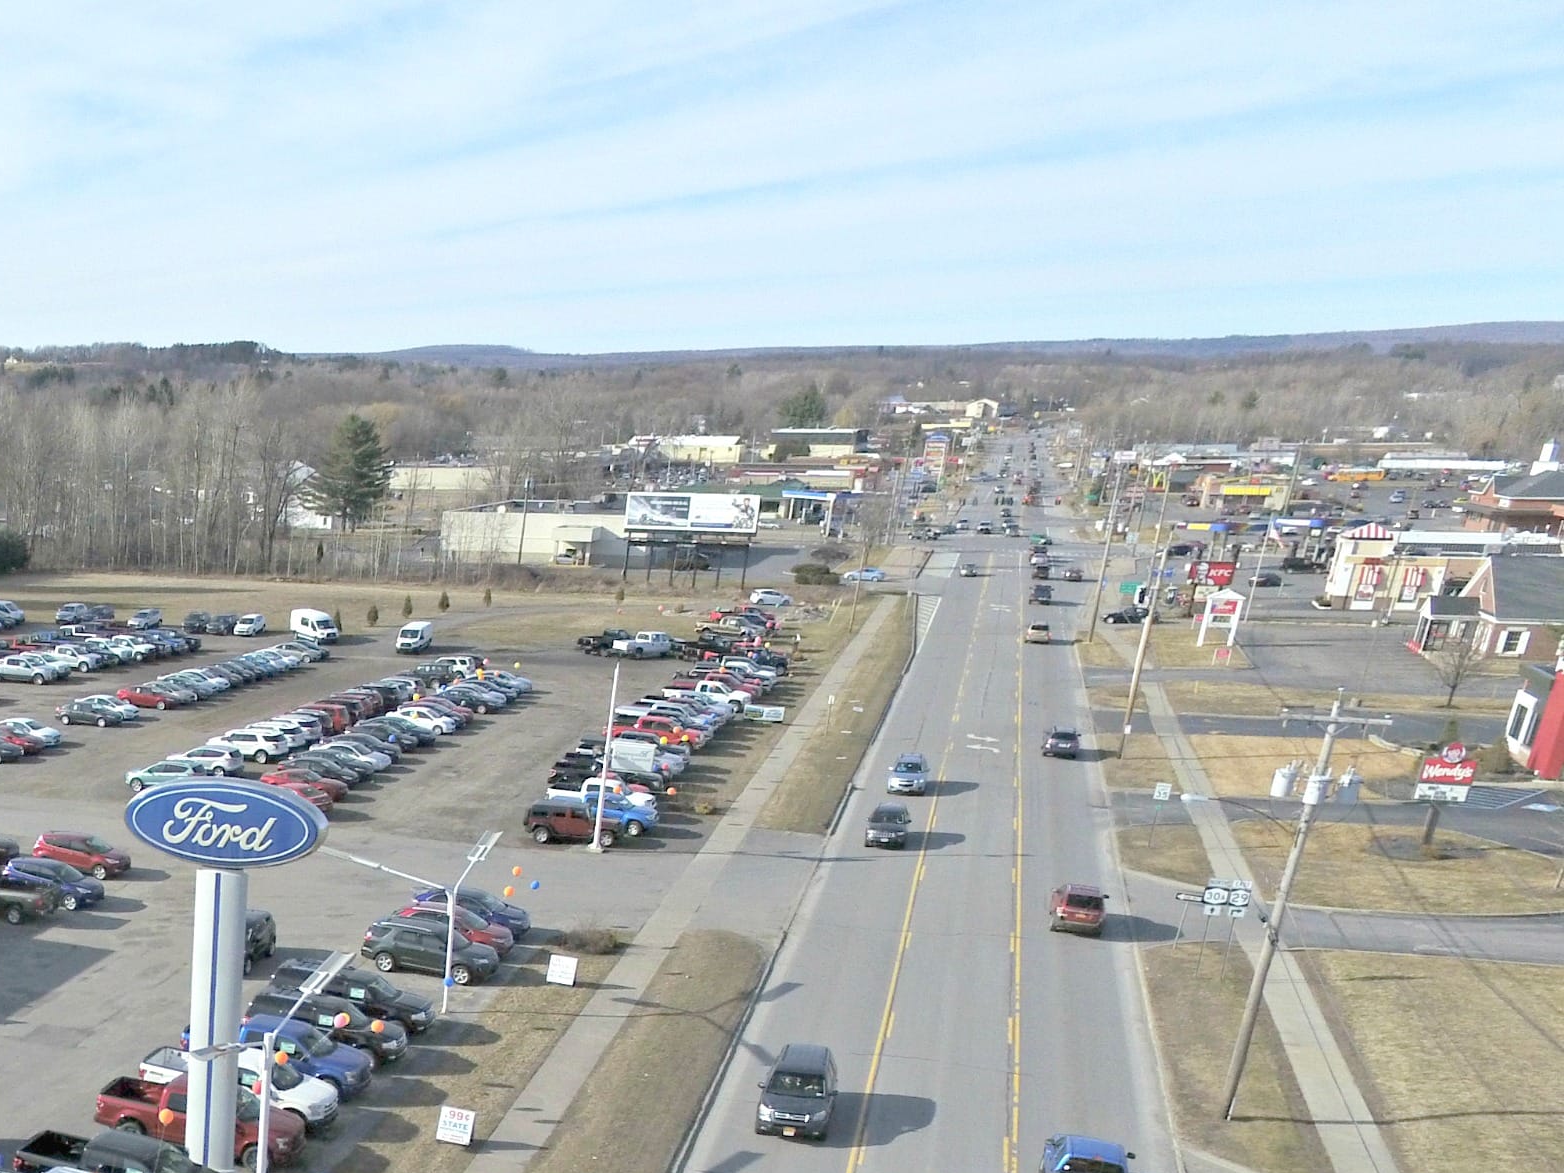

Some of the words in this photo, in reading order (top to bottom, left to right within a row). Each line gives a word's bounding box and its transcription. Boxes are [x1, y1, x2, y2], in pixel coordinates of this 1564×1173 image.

[1208, 568, 1233, 577] KFC
[1422, 763, 1474, 781] Wendy's
[162, 797, 278, 852] Ford
[1232, 893, 1249, 903] 29
[442, 1119, 469, 1131] STATE
